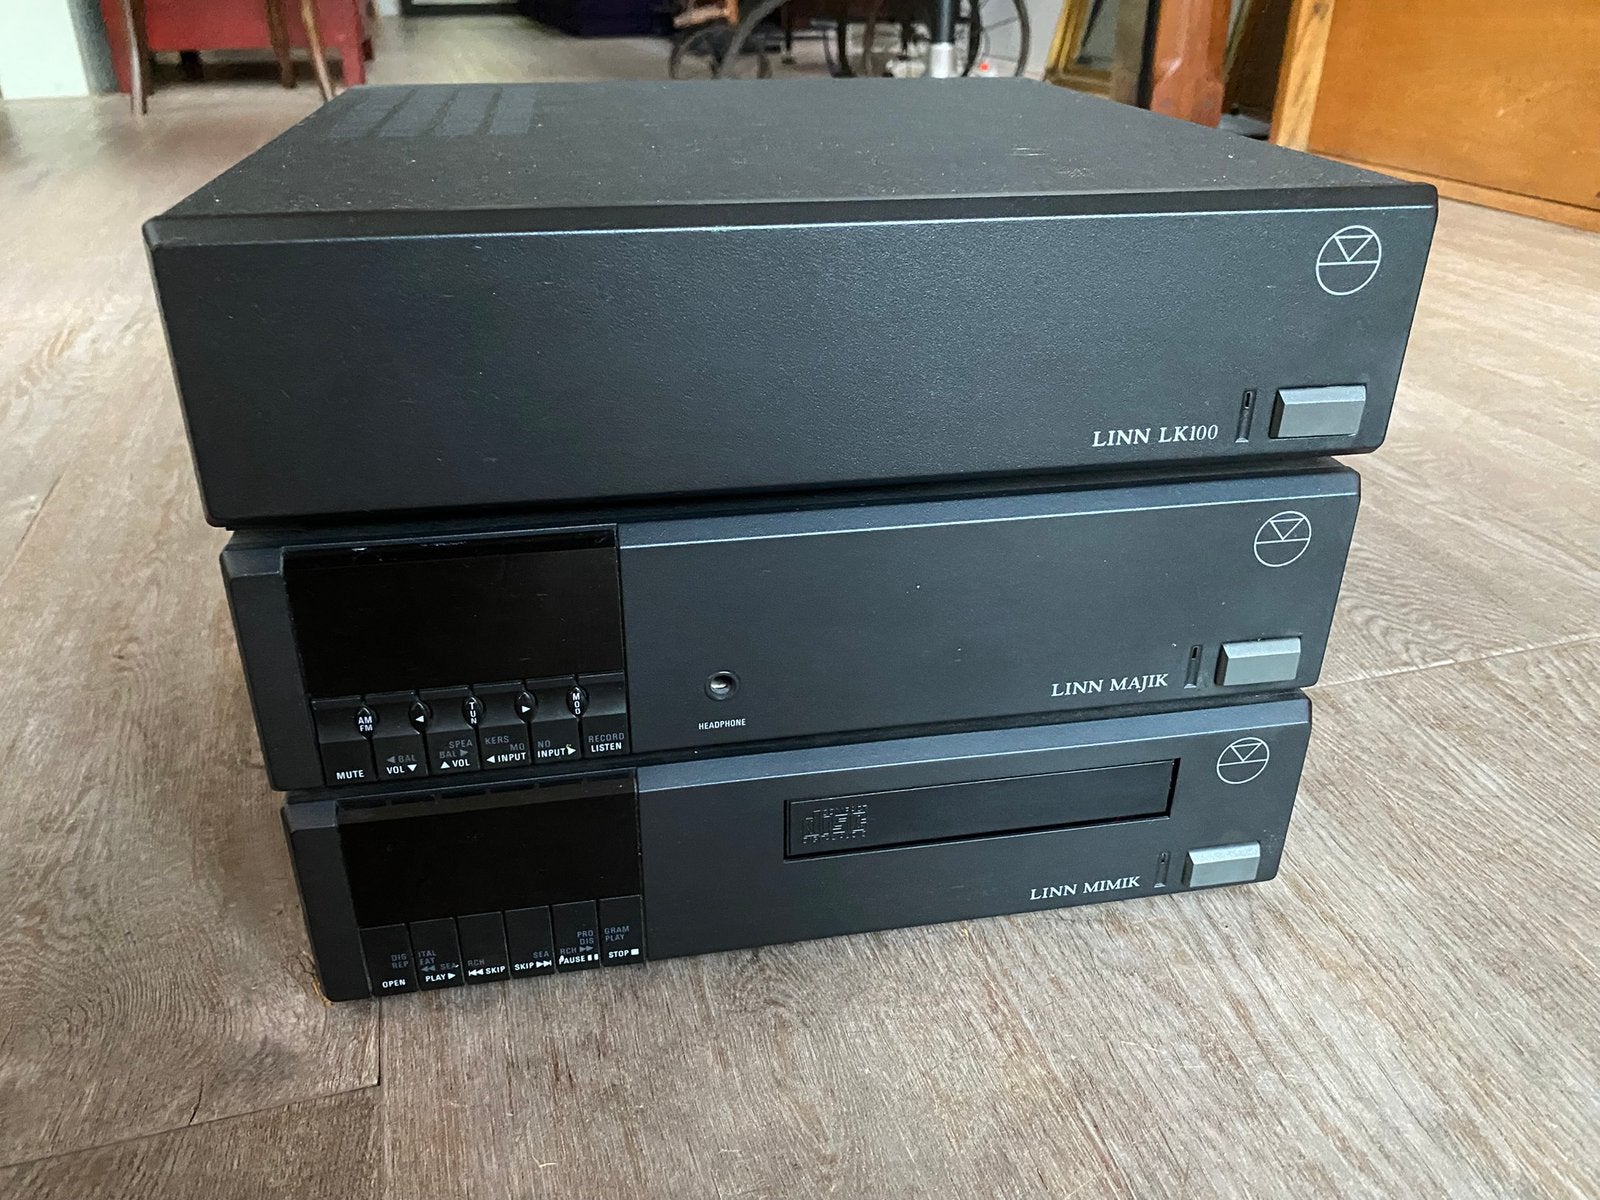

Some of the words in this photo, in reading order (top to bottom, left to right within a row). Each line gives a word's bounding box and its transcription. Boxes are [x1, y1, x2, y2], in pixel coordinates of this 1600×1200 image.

[1092, 428, 1151, 447] LINN
[1158, 424, 1219, 443] LK100
[1051, 679, 1104, 697] LINN
[1109, 673, 1169, 693] MAJIK
[358, 716, 373, 724] AM
[698, 718, 747, 730] HEADPHONE
[360, 724, 373, 732] FM
[485, 735, 510, 745] KERS
[588, 732, 625, 743] RECORD
[448, 739, 473, 749] SPEA
[509, 742, 525, 751] MO
[537, 740, 551, 748] NO
[591, 742, 622, 753] LISTEN
[439, 750, 457, 759] BAL
[497, 752, 526, 763] INPUT
[537, 747, 565, 758] INPUT
[398, 754, 416, 763] BAL
[452, 758, 471, 768] VOL
[336, 769, 365, 780] MUTE
[386, 765, 406, 775] VOL
[1029, 883, 1078, 900] LINN
[1082, 875, 1141, 894] MIMIK
[577, 929, 594, 939] PRO
[604, 925, 630, 935] GRAM
[605, 934, 625, 943] PLAY
[608, 949, 630, 959] STOP
[559, 955, 586, 965] PAUSE
[485, 965, 506, 975] SKIP
[514, 961, 535, 971] SKIP
[425, 973, 446, 983] PLAY
[382, 978, 406, 989] OPEN
